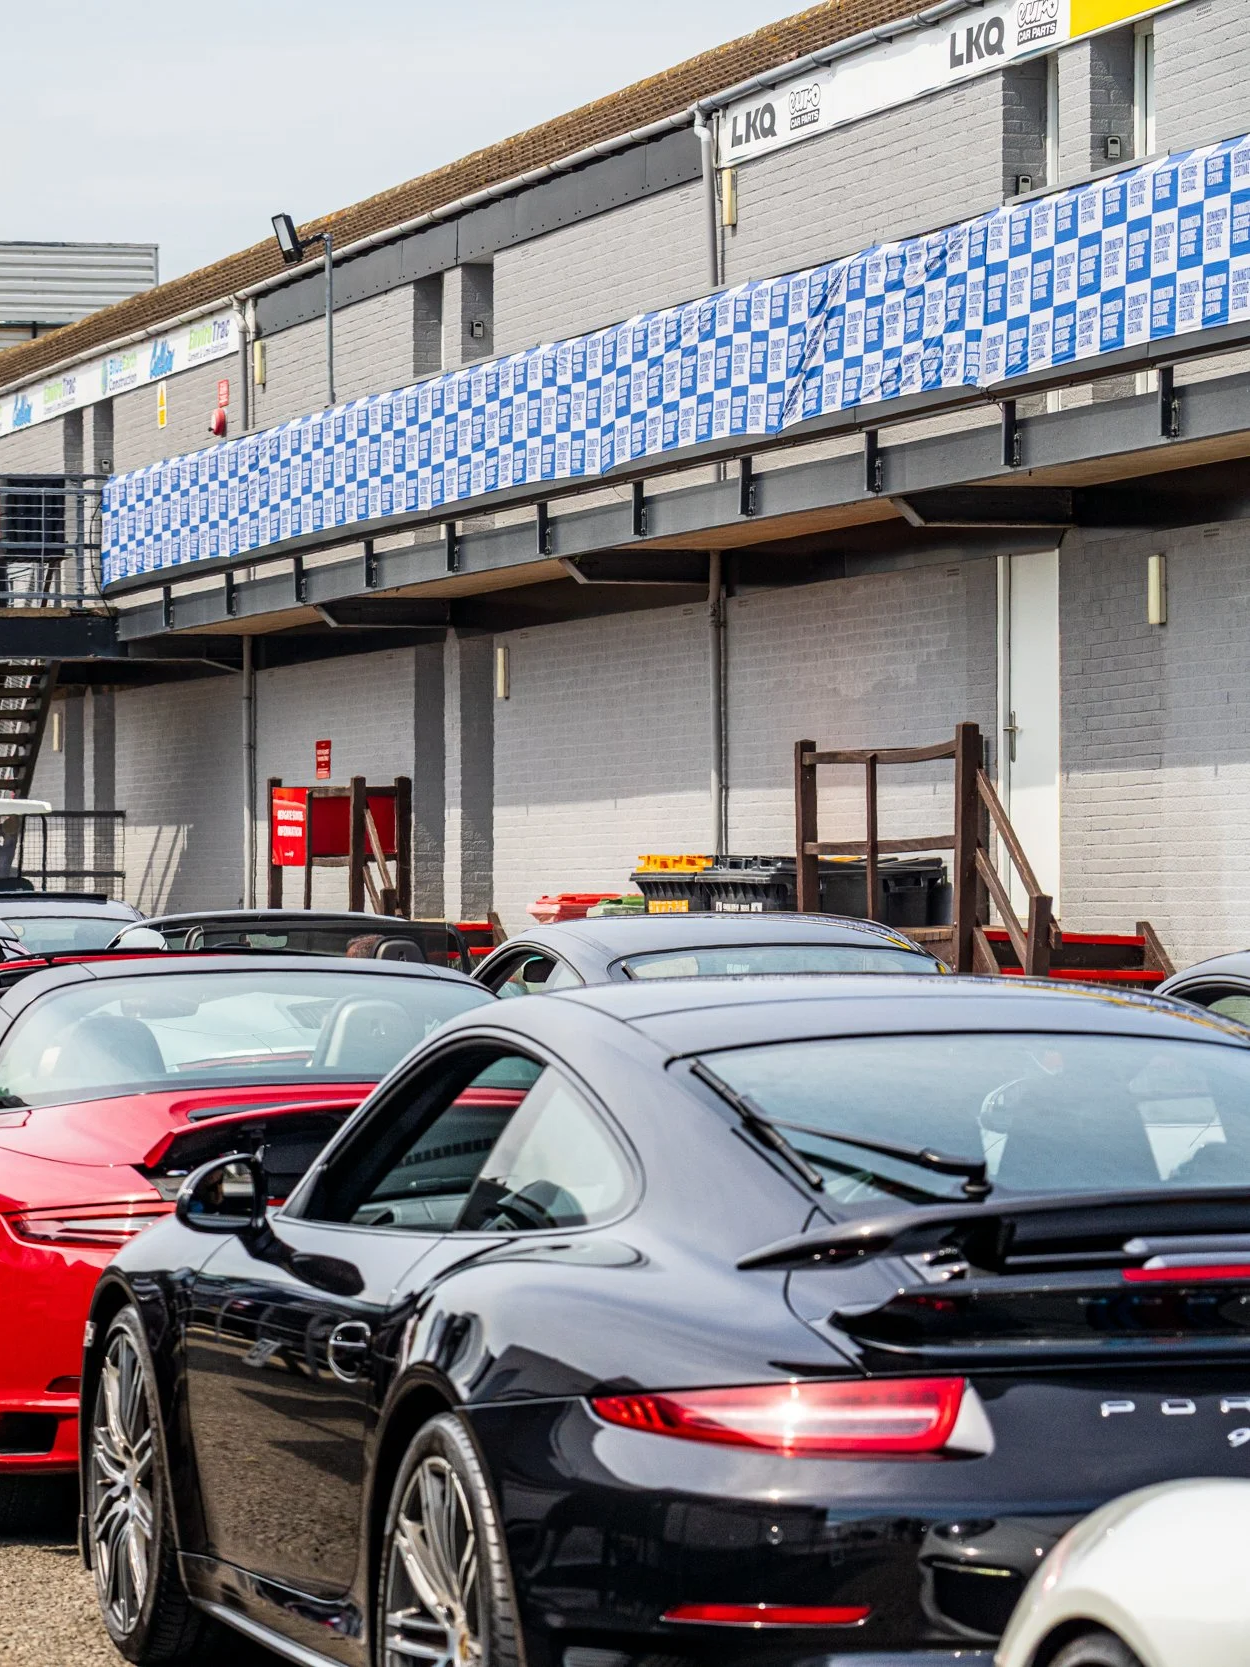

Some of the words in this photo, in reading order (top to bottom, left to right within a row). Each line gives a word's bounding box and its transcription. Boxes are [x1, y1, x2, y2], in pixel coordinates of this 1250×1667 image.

[950, 16, 1005, 69] LKQ
[1018, 31, 1031, 43] CAR
[1032, 22, 1056, 38] PARTS
[789, 83, 821, 115] euro
[731, 102, 777, 148] LKQ
[791, 118, 800, 129] CAR
[801, 110, 819, 125] PARTS
[1101, 1396, 1250, 1417] POR
